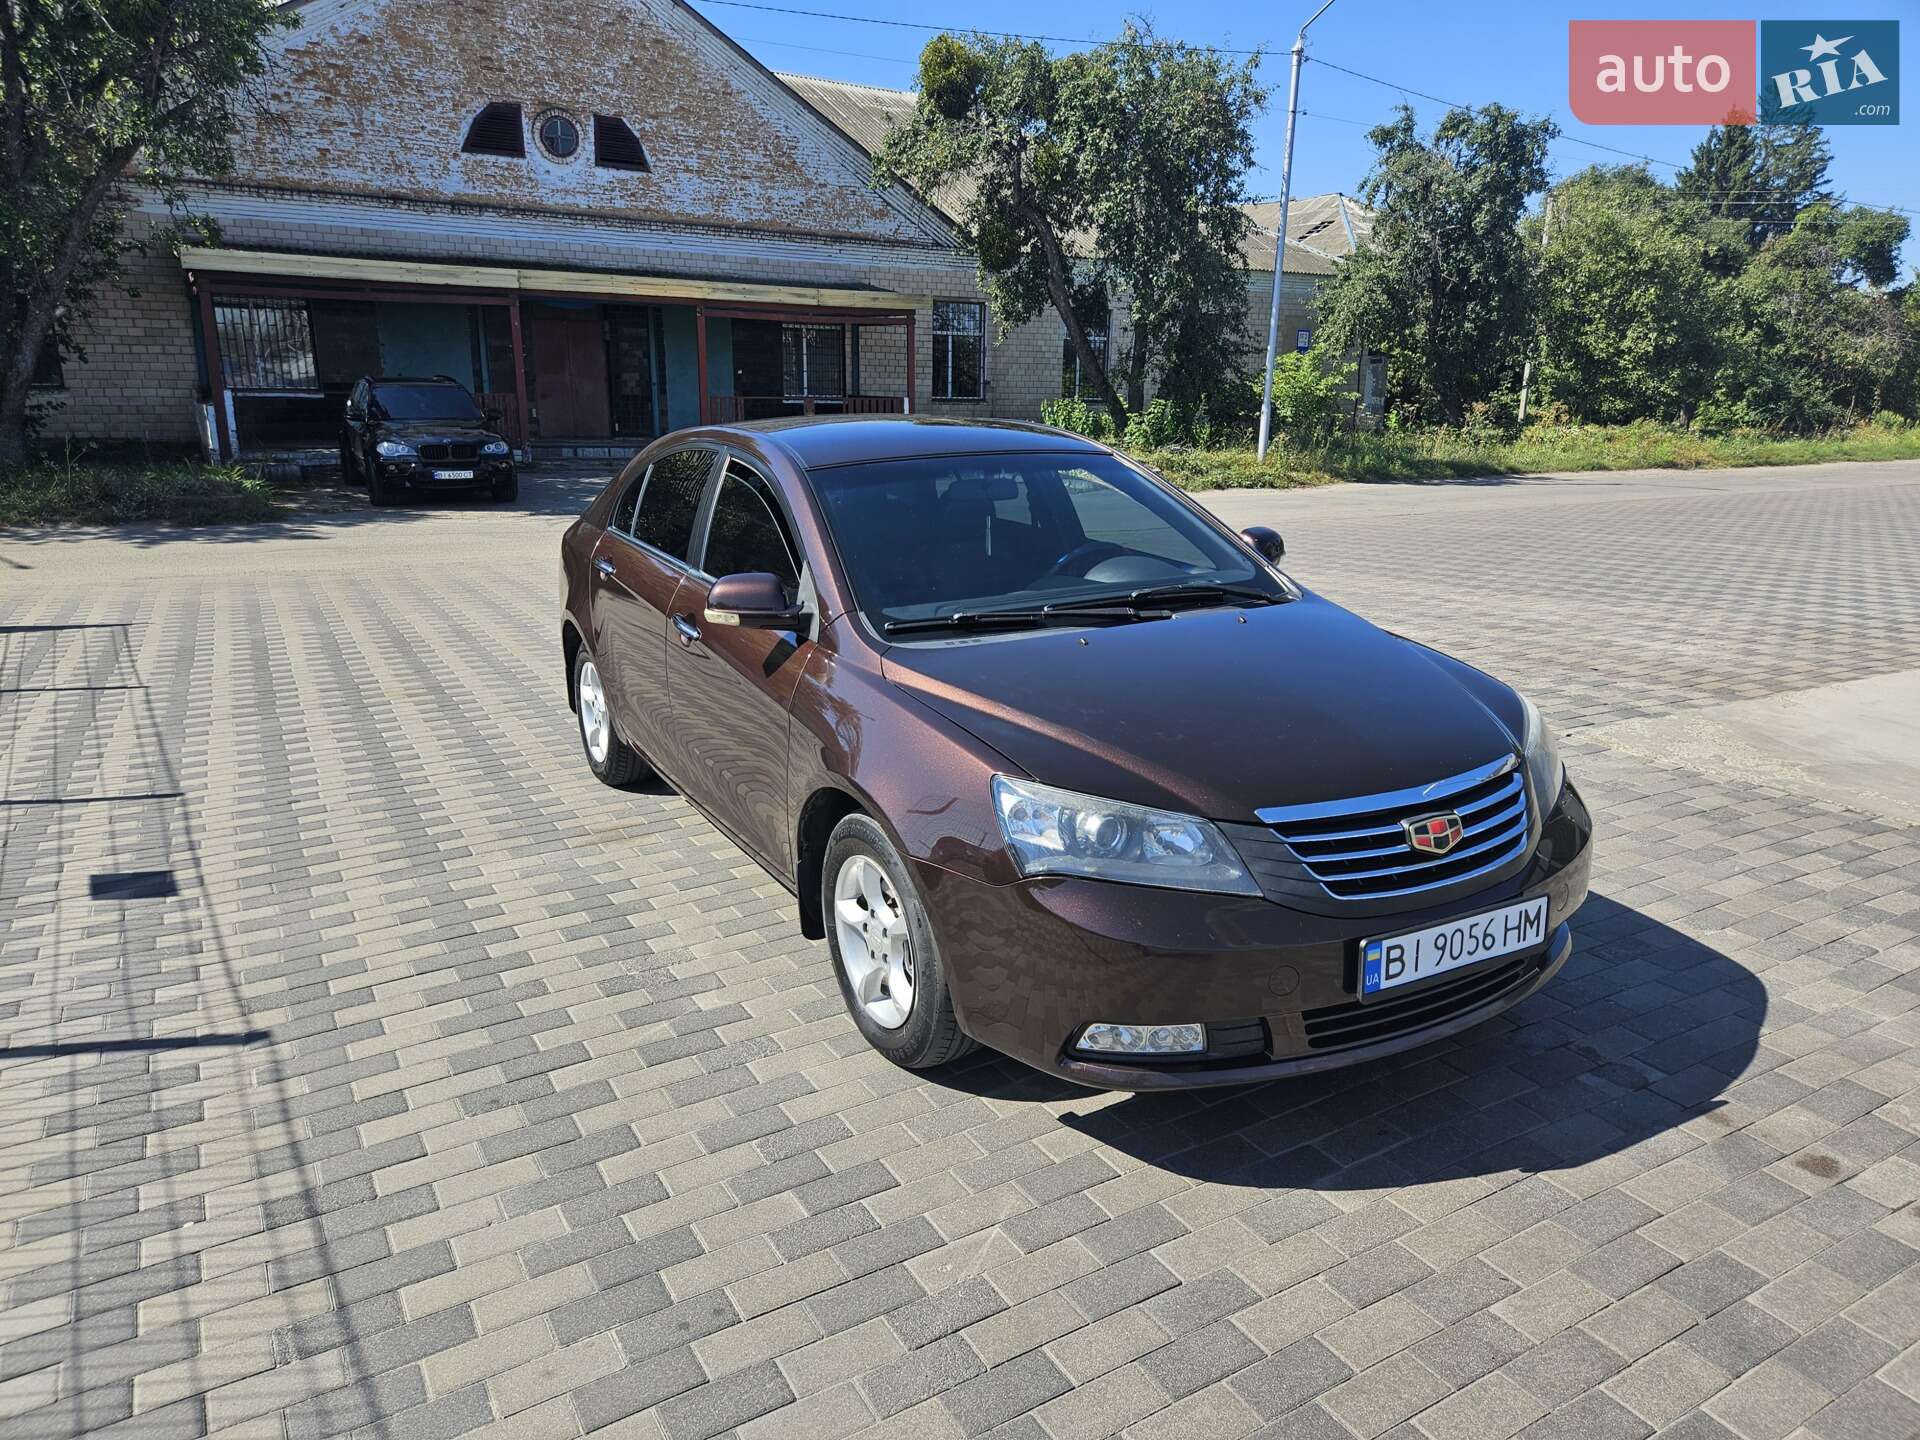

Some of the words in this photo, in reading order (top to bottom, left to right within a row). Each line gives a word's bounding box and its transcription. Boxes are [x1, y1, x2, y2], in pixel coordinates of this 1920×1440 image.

[1384, 939, 1420, 981] BI
[1434, 918, 1496, 967] 9056
[1503, 905, 1542, 947] HM
[1366, 973, 1380, 986] UA
